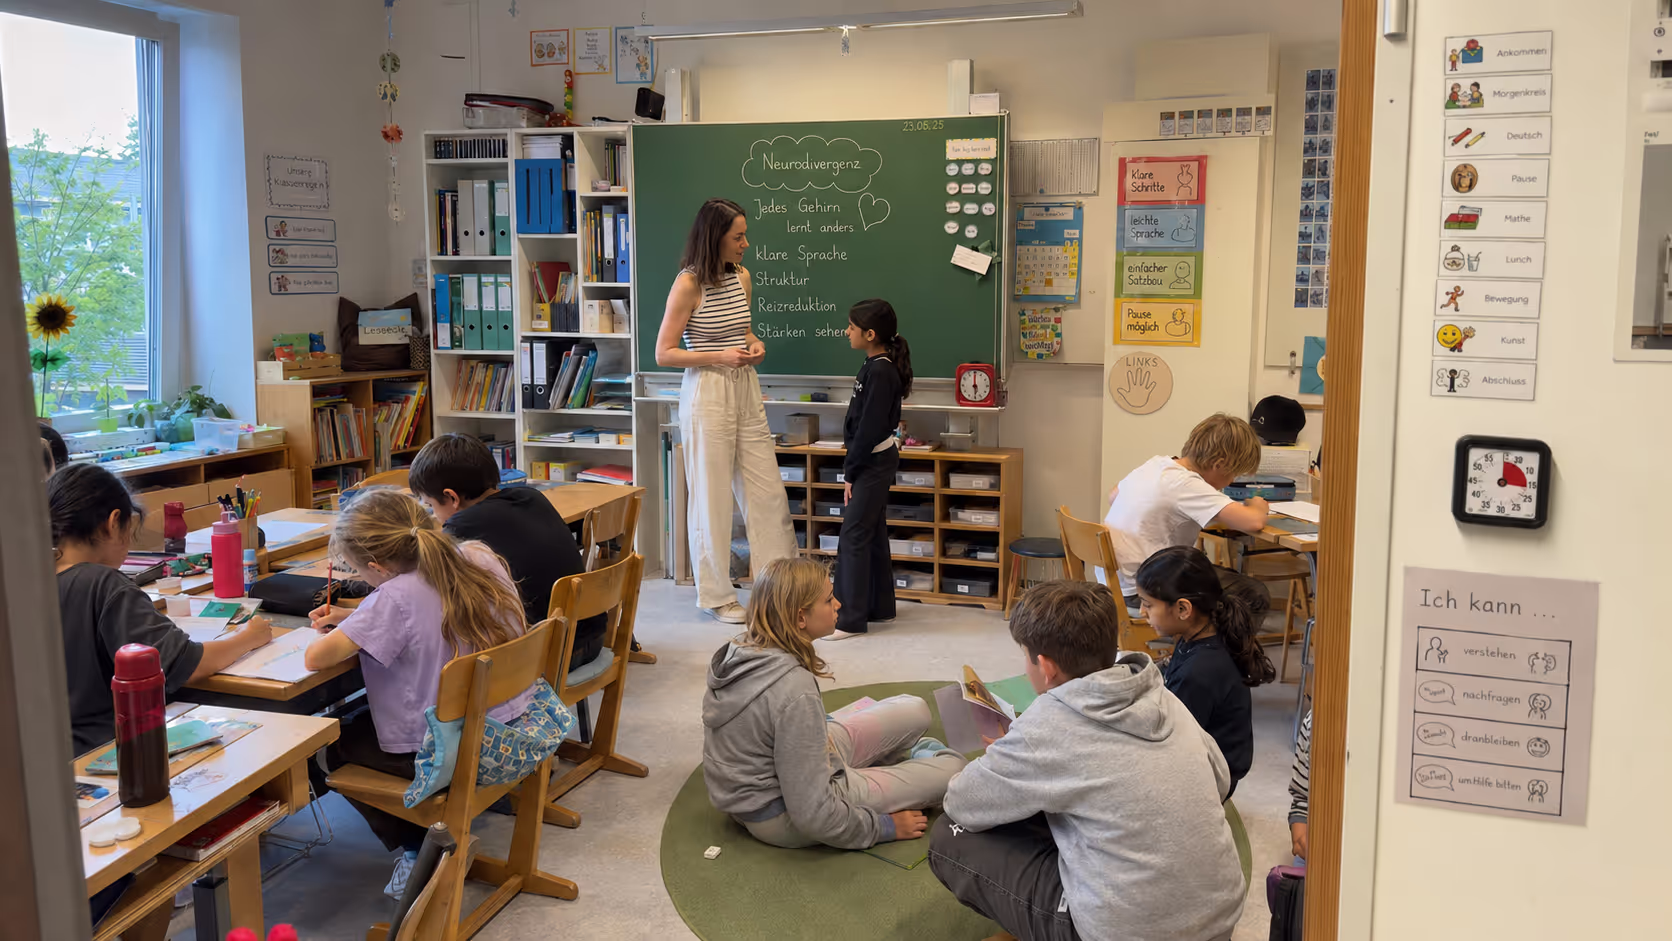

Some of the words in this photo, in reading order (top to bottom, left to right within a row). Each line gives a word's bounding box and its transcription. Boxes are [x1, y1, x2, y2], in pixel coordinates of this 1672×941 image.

[1496, 47, 1547, 58] Ankommen
[1492, 88, 1547, 99] Morgenkreis
[1506, 131, 1543, 140] Deutsch
[762, 152, 861, 176] Neurodivergenz
[1131, 168, 1154, 180] Klare
[1511, 174, 1538, 183] Pause
[1130, 182, 1165, 193] Schritte
[754, 198, 788, 220] Jedes
[797, 196, 841, 213] Gehirn
[1130, 214, 1159, 226] leichte
[1504, 214, 1531, 223] Mathe
[786, 219, 812, 233] lernt
[820, 219, 855, 233] anders
[1130, 229, 1165, 241] Sprache
[797, 244, 848, 267] Sprache
[1505, 255, 1532, 264] Lunch
[1127, 262, 1168, 273] einfacher
[755, 271, 810, 286] Struktur
[1128, 274, 1163, 286] Satzbau
[758, 297, 837, 313] Reizreduktion
[1484, 294, 1529, 305] Bewegung
[1127, 308, 1152, 319] Pause
[757, 323, 806, 339] Stärken
[815, 323, 848, 338] sehen
[1126, 321, 1160, 335] möglich
[1500, 336, 1526, 345] Kunst
[1125, 356, 1159, 368] LINKS
[1482, 375, 1526, 385] Abschluss
[1484, 454, 1493, 462] 55
[1473, 462, 1482, 471] 50
[1526, 467, 1534, 475] 10
[1528, 481, 1537, 489] 15
[1471, 490, 1481, 498] 40
[1481, 500, 1491, 509] 35
[1496, 505, 1505, 514] 30
[1511, 503, 1521, 511] 25
[1419, 588, 1457, 609] Ich
[1469, 591, 1521, 615] kann
[1463, 646, 1517, 660] verstehen
[1462, 690, 1521, 706] nachfragen
[1461, 731, 1520, 748] dranbleiben
[1495, 778, 1522, 791] bitten
